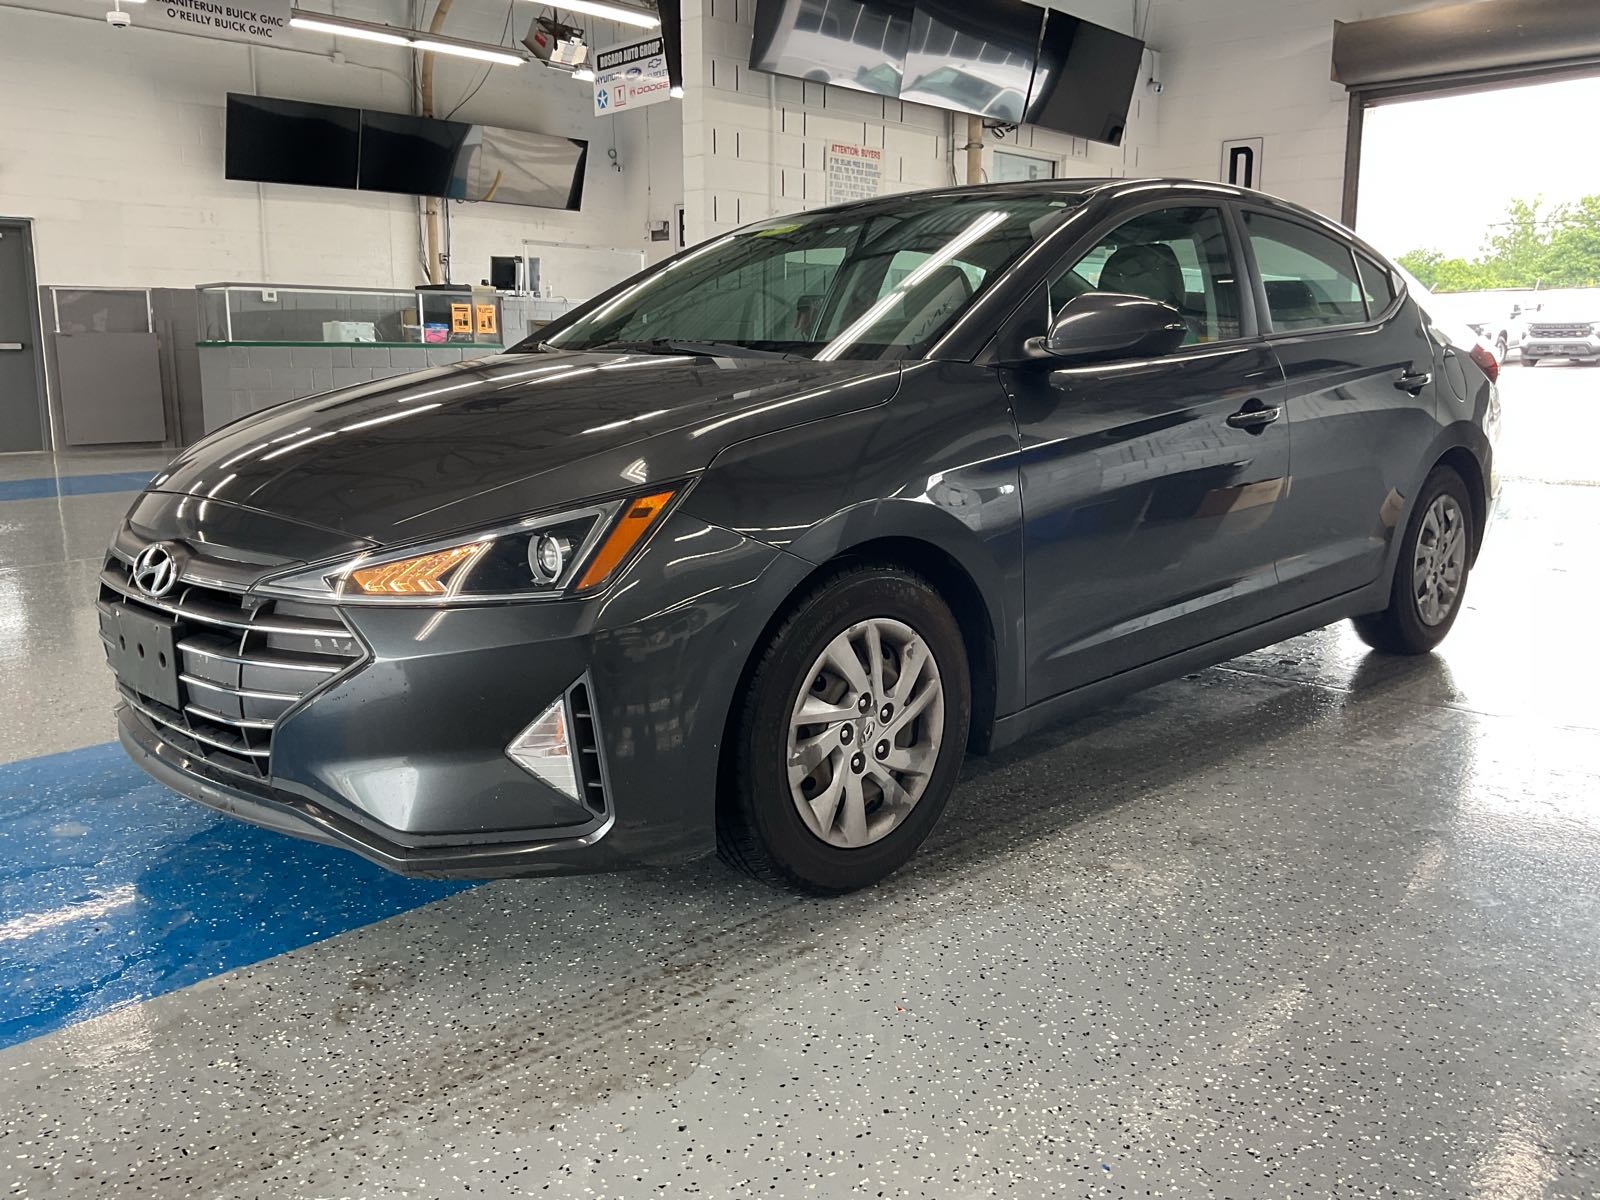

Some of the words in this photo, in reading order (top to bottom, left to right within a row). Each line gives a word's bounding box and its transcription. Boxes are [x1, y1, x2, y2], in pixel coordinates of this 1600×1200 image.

[166, 8, 212, 26] O'REILLY
[214, 17, 246, 33] BUICK
[248, 25, 274, 38] GMC
[226, 7, 257, 22] BUICK
[260, 14, 284, 28] GMC
[623, 46, 638, 62] AUTO
[639, 40, 661, 57] GROUP
[595, 71, 623, 86] HYUNDAI
[636, 81, 669, 95] DODGE
[860, 149, 881, 160] BUYERS
[1228, 146, 1254, 189] D
